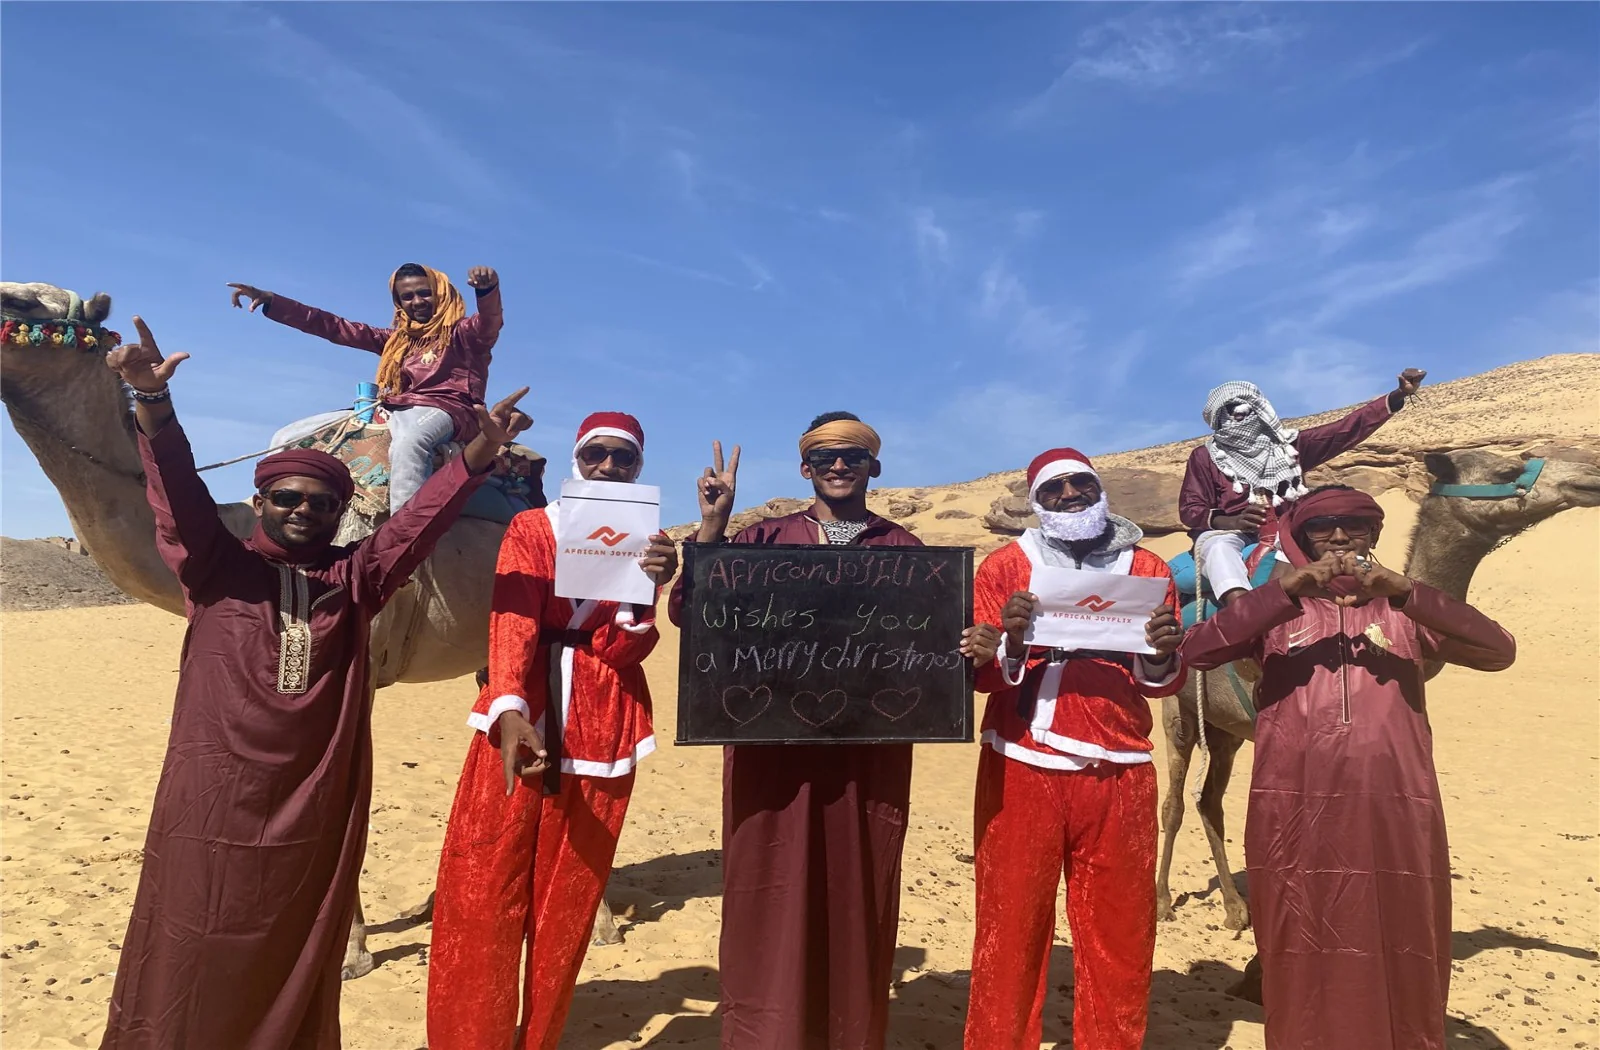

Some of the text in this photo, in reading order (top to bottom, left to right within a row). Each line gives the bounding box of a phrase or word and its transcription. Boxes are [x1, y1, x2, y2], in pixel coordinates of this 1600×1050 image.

[564, 547, 606, 556] AFRICAN
[1052, 612, 1132, 624] AFRICAN JOYFLIX
[695, 652, 717, 673] a
